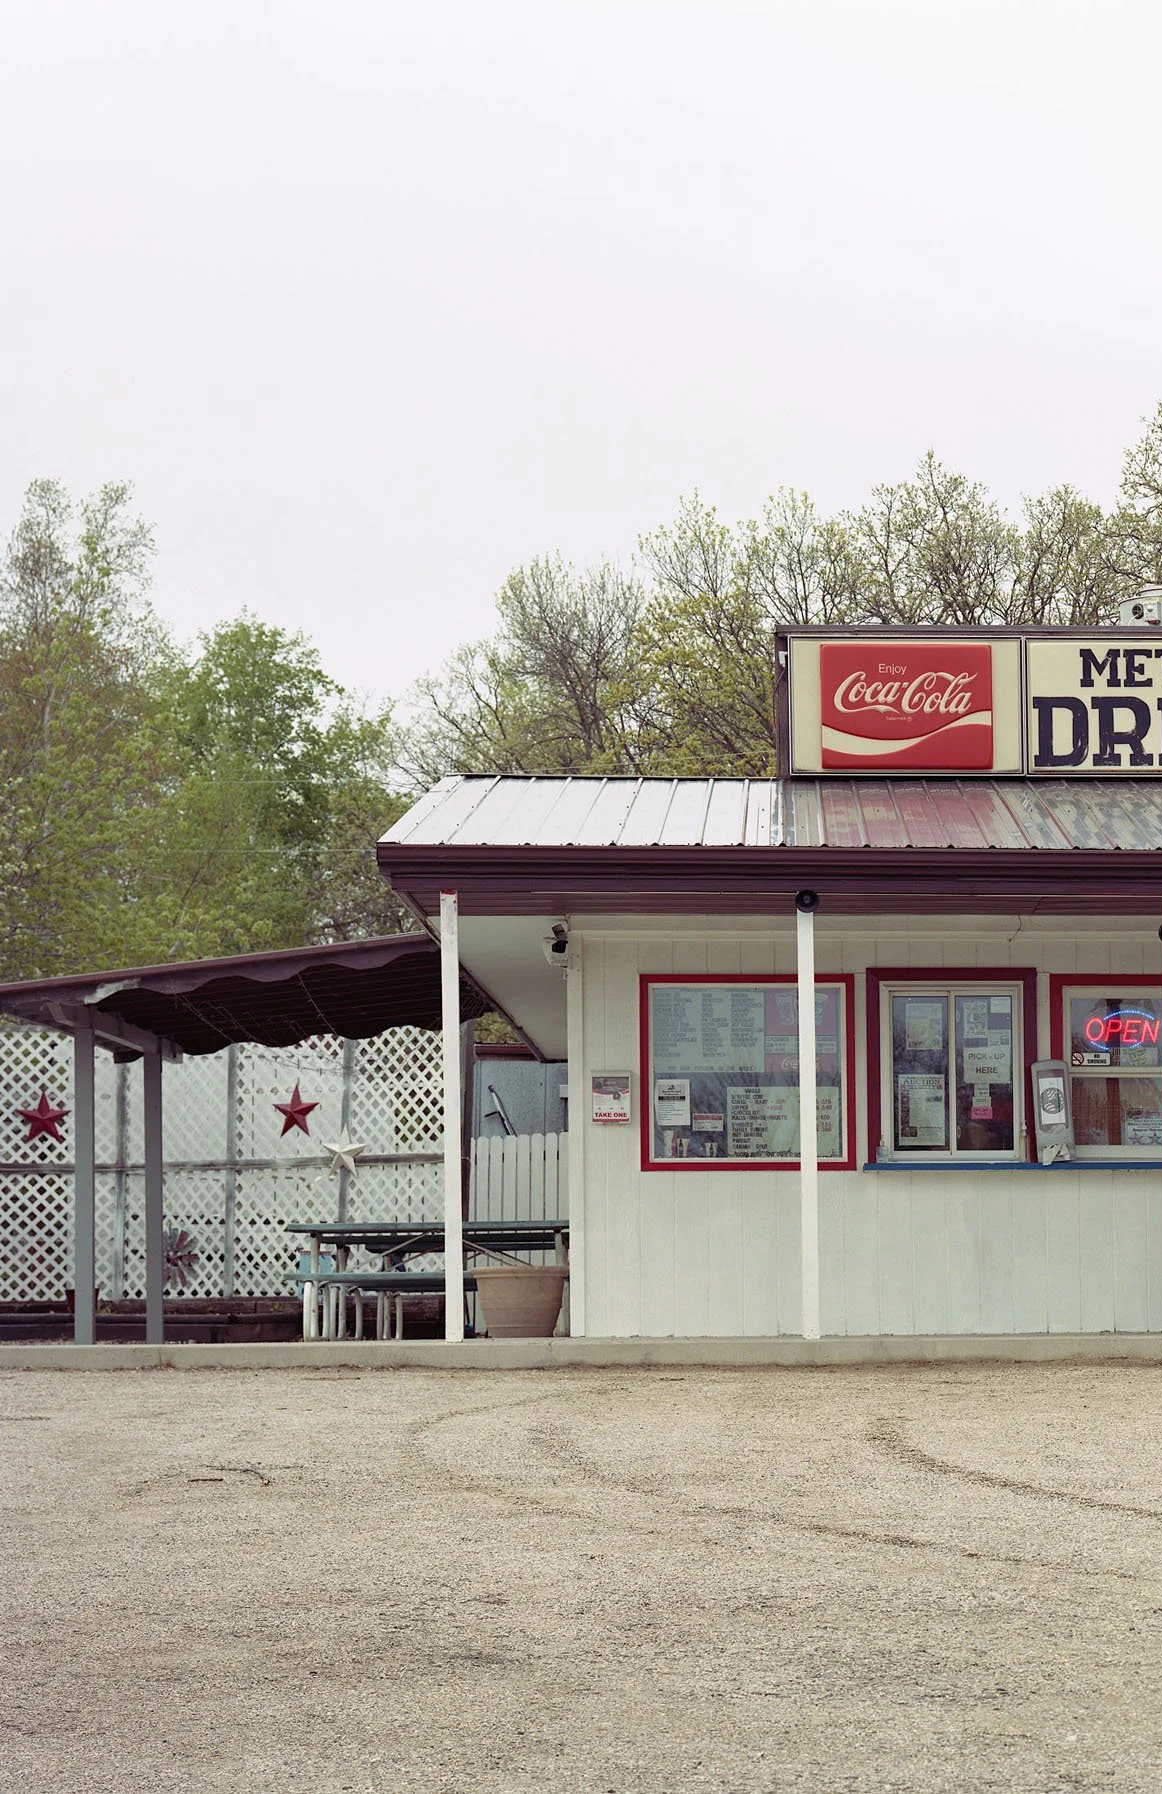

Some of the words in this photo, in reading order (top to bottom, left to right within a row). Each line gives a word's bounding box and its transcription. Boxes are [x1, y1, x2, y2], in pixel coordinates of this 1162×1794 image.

[878, 663, 907, 676] Enjoy
[833, 670, 978, 715] Coca-Cola
[1085, 1016, 1161, 1044] OPEN
[975, 1066, 998, 1074] HERE
